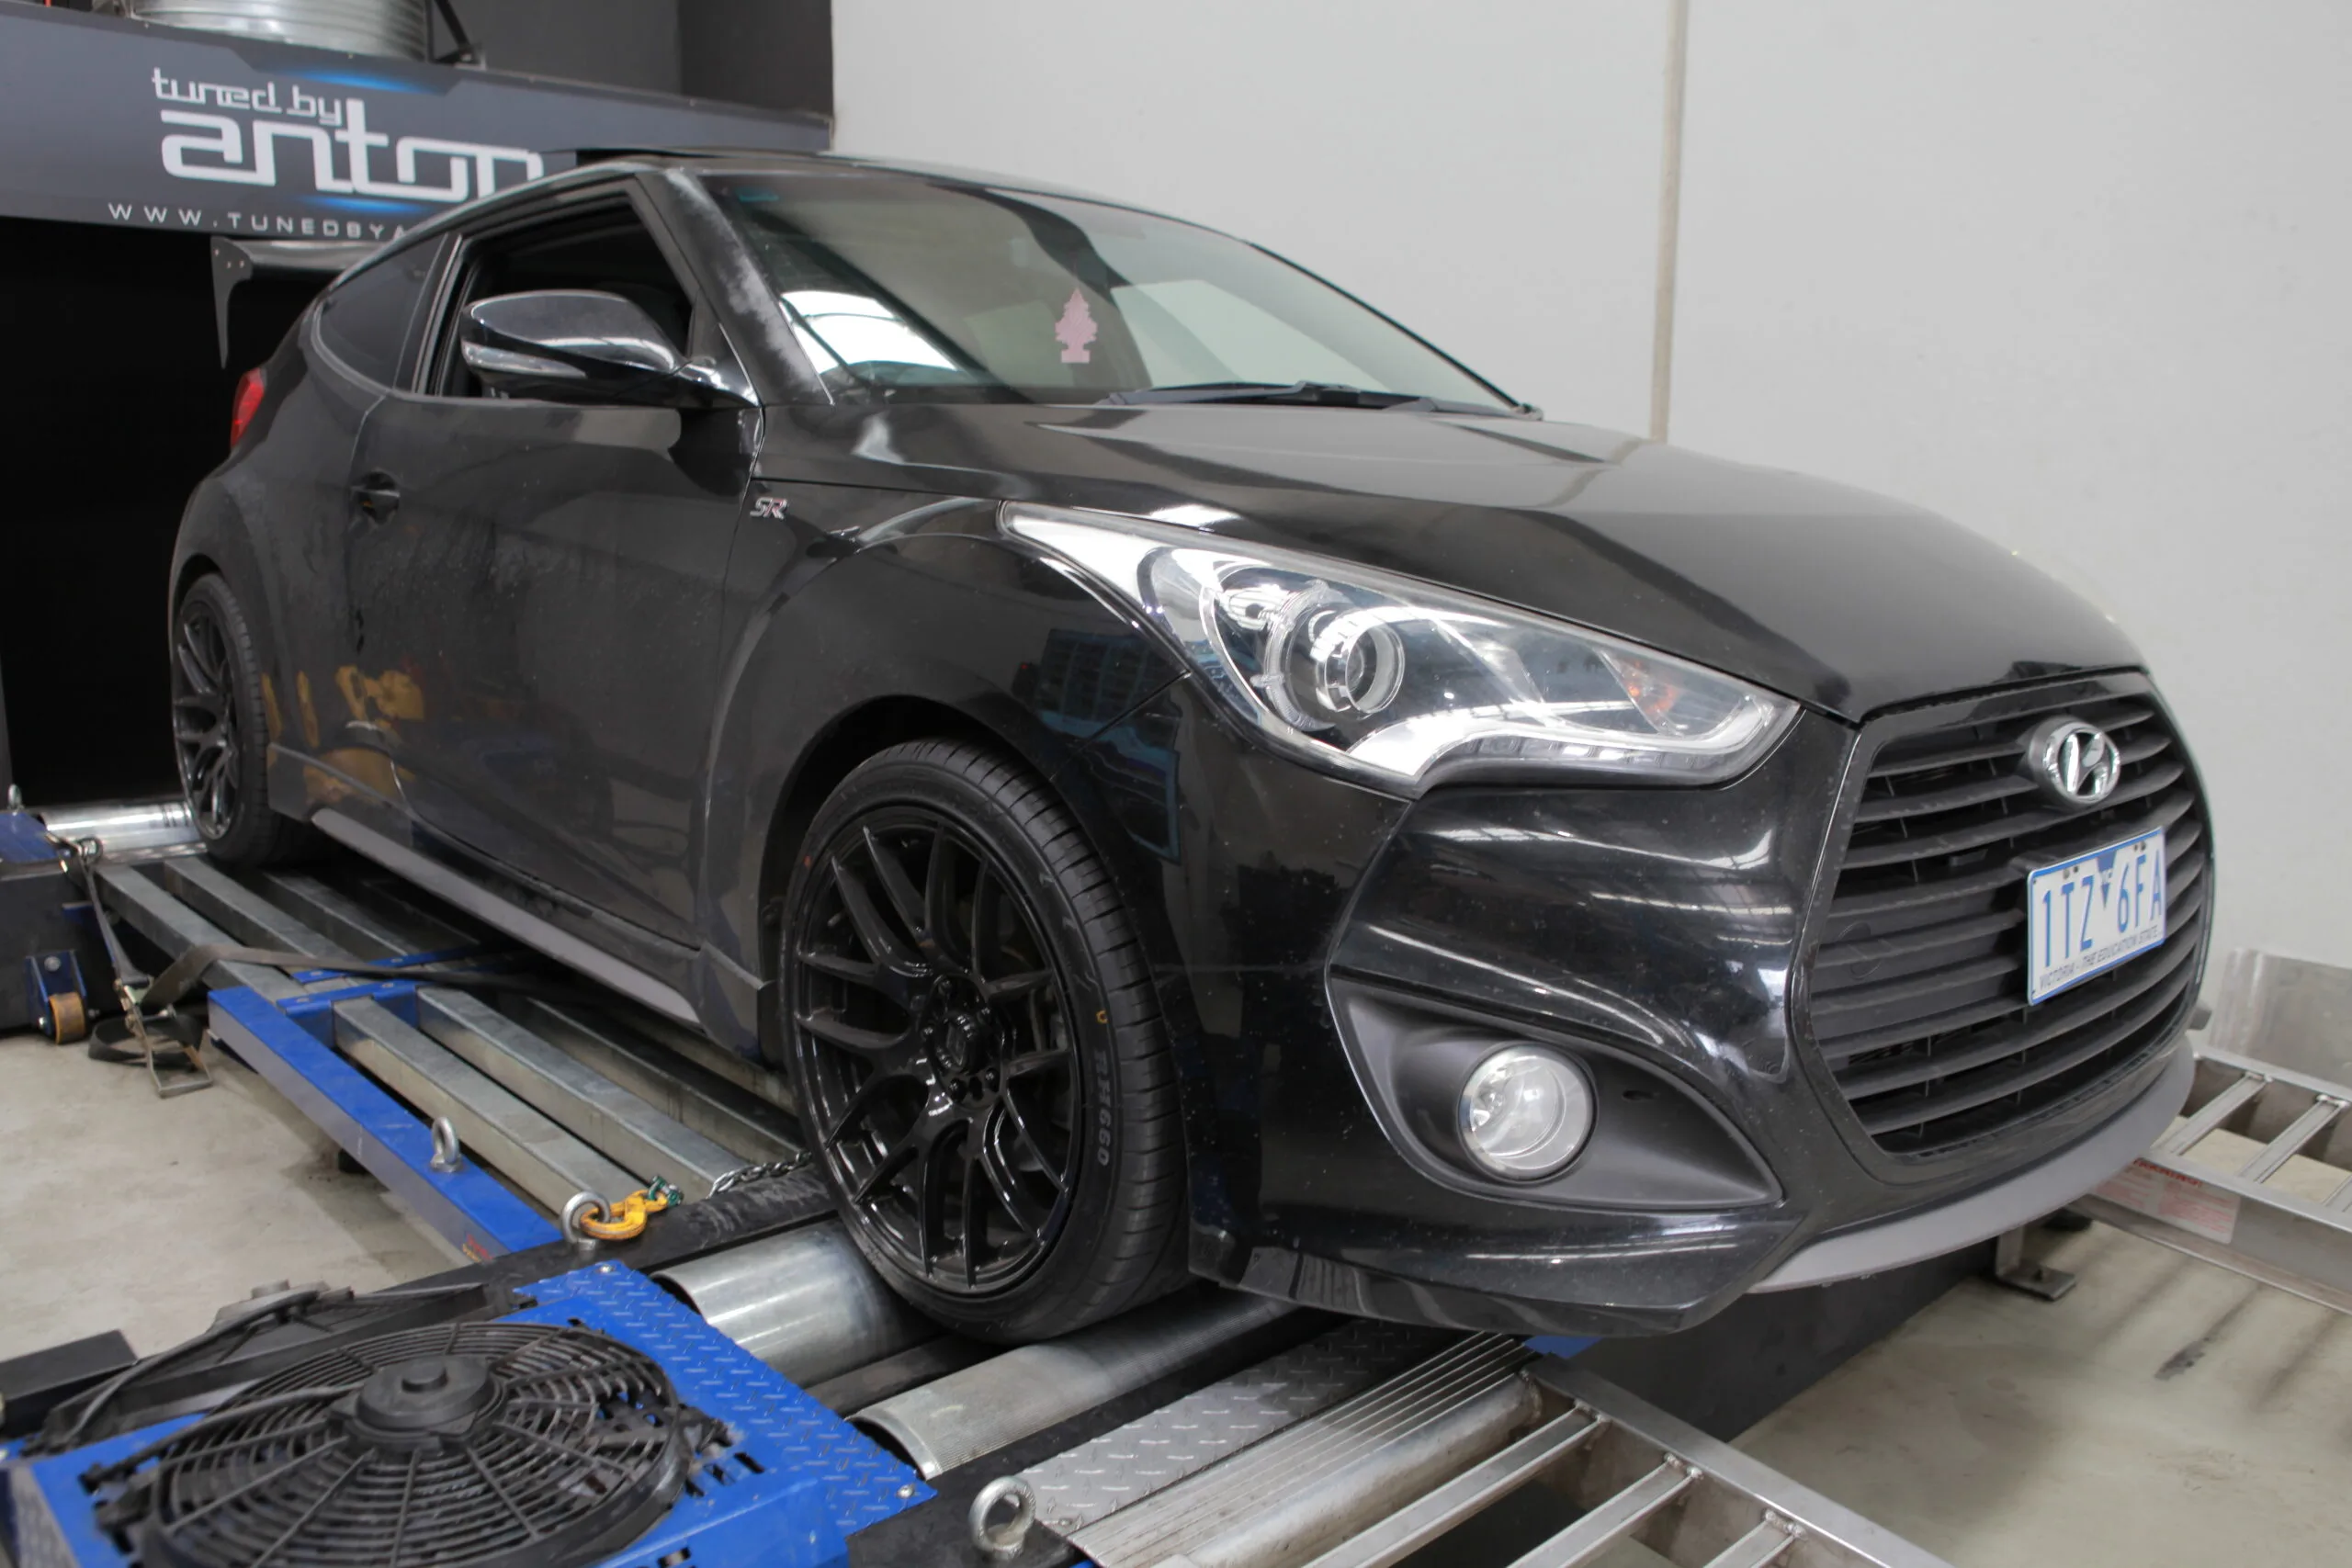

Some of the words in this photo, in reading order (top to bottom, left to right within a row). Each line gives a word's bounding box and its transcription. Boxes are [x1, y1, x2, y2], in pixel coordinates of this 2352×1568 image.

[152, 67, 283, 115] tuned
[287, 85, 342, 127] by
[160, 97, 544, 202] anton
[750, 497, 787, 520] SR
